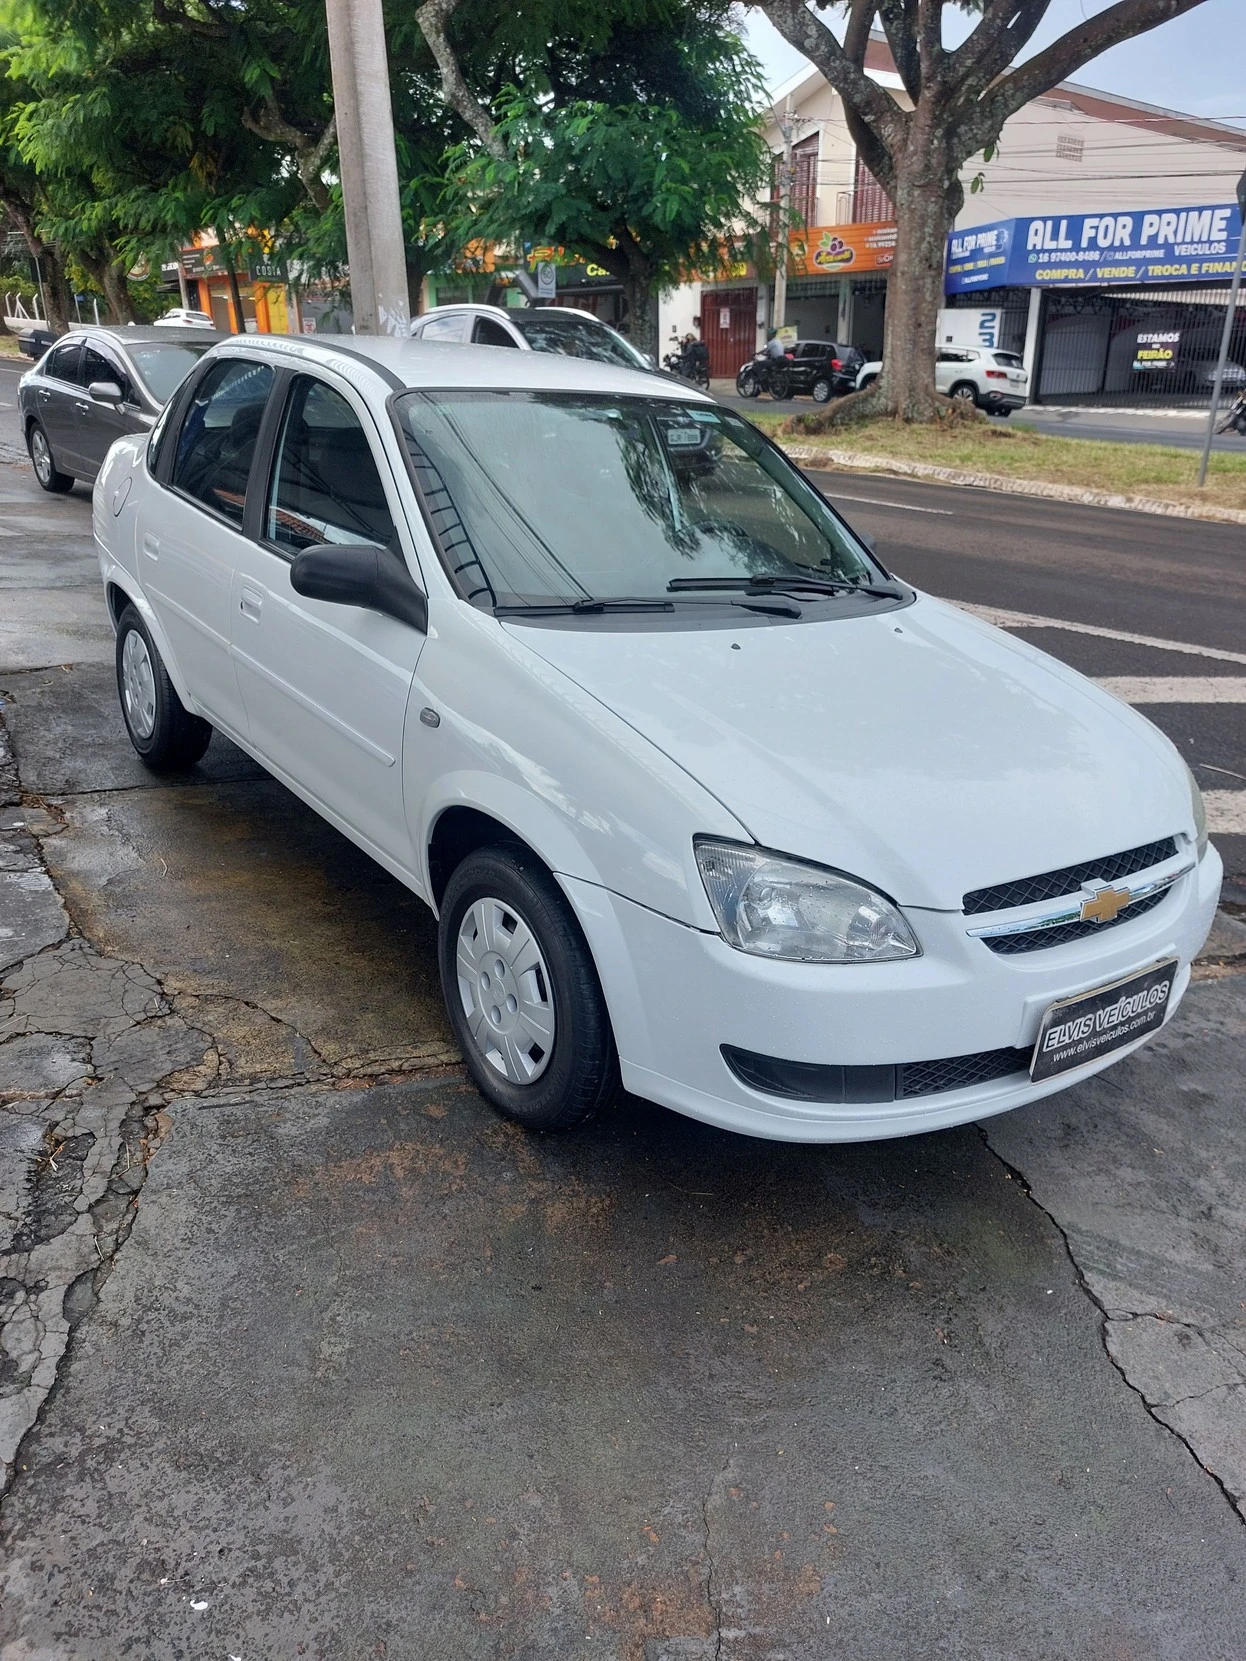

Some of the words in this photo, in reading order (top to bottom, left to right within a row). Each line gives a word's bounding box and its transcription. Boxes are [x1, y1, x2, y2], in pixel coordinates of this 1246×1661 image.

[1026, 219, 1074, 251] ALL
[1081, 216, 1134, 248] FOR
[1140, 208, 1232, 245] PRIME
[1174, 241, 1227, 257] VEICULOS
[1035, 266, 1085, 280] COMPRA
[1096, 265, 1137, 279] VENDE
[1147, 263, 1188, 277] TROCA
[1190, 263, 1200, 275] E
[1136, 332, 1180, 343] ESTAMOS
[1137, 348, 1173, 359] FEIRÃO
[1043, 1012, 1094, 1053] ELVIS
[1095, 980, 1170, 1032] VEÍCULOS
[1052, 1011, 1156, 1063] www.elvisveiculos.com.br
